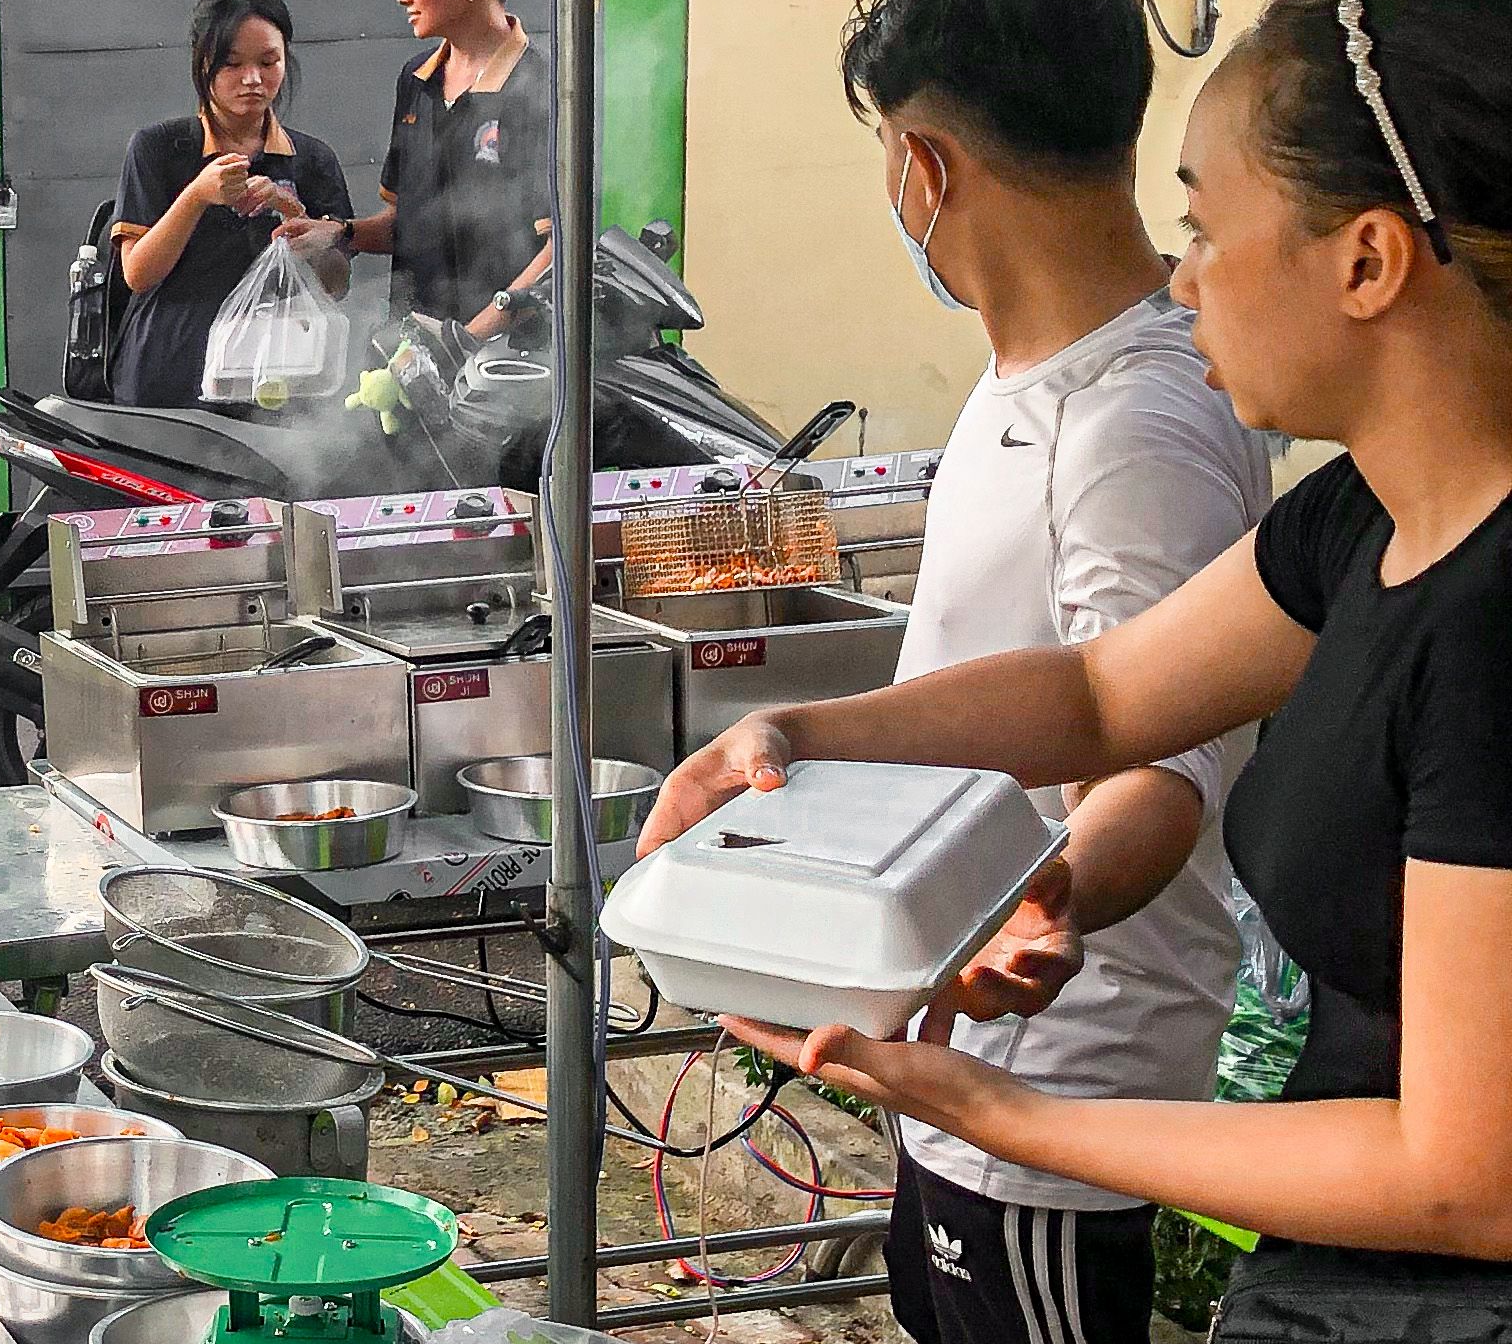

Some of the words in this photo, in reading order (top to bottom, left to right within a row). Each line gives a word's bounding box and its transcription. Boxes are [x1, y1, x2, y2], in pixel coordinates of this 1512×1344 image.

[726, 641, 757, 653] SHUN
[449, 673, 481, 686] SHUN
[175, 688, 209, 700] SHUN
